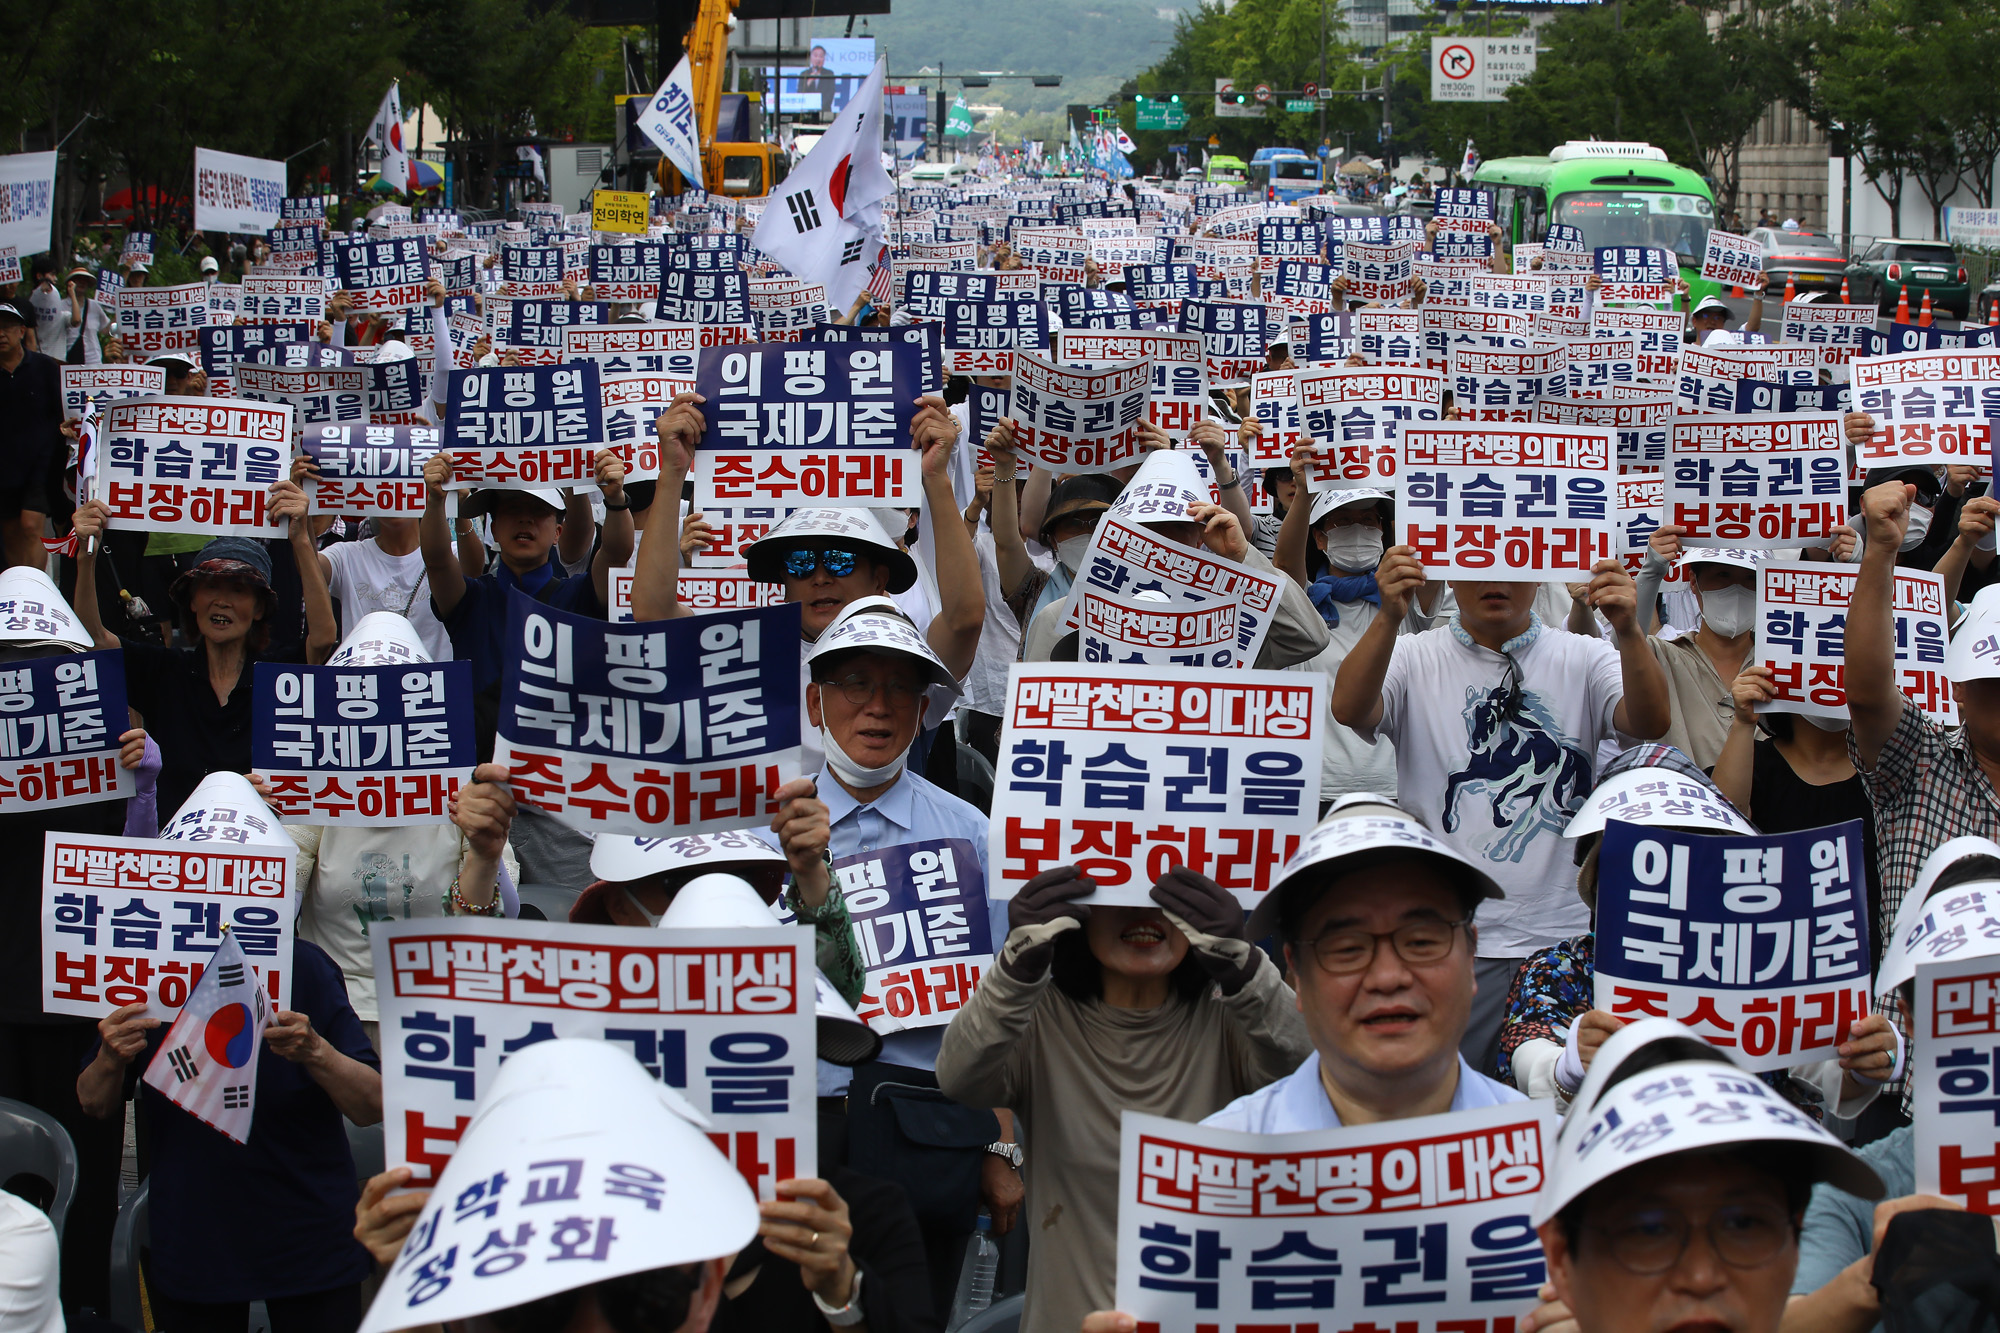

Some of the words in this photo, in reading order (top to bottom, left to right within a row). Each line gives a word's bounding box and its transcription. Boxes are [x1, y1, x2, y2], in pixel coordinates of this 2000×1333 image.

[285, 198, 320, 210] 의평원
[1440, 190, 1488, 204] 의평원
[284, 208, 322, 219] 국제기준
[595, 208, 644, 224] 전의학연
[1438, 204, 1489, 218] 국제기준
[284, 219, 324, 229] 준수하라!
[1263, 225, 1316, 240] 의평원
[1332, 218, 1382, 231] 의평원
[1388, 216, 1423, 229] 의평원
[272, 238, 316, 252] 국제기준
[273, 227, 314, 242] 의평원
[1332, 229, 1383, 242] 국제기준
[1388, 228, 1424, 242] 국제기준
[272, 252, 318, 264] 준수하라!
[348, 240, 420, 268] 의평원
[508, 250, 558, 266] 의평원
[597, 247, 661, 265] 의평원
[1020, 247, 1086, 266] 학습권을
[1095, 248, 1152, 262] 학습권을
[1262, 242, 1317, 256] 국제기준
[1435, 242, 1487, 256] 국제기준
[1602, 248, 1660, 266] 의평원
[1708, 247, 1760, 270] 학습권을
[675, 252, 736, 272] 의평원
[1347, 258, 1411, 280] 학습권을
[350, 262, 424, 288] 국제기준
[508, 266, 558, 282] 국제기준
[597, 266, 661, 282] 국제기준
[1132, 265, 1188, 284] 의평원
[1286, 264, 1343, 283] 의평원
[1602, 266, 1664, 283] 국제기준
[666, 271, 741, 298] 의평원
[912, 274, 987, 296] 의평원
[1133, 282, 1192, 299] 국제기준
[1346, 280, 1412, 300] 보장하라!
[1600, 285, 1666, 301] 준수하라!
[244, 296, 322, 315] 학습권을
[351, 284, 428, 310] 준수하라!
[1068, 291, 1130, 310] 의평원
[1472, 292, 1546, 310] 학습권을
[120, 304, 207, 329] 학습권을
[522, 304, 598, 325] 의평원
[662, 299, 744, 322] 국제기준
[956, 304, 1038, 326] 의평원
[1186, 304, 1260, 332] 의평원
[956, 327, 1039, 349] 국제기준
[720, 350, 893, 396] 의평원
[460, 370, 584, 408] 의평원
[1456, 375, 1567, 405] 학습권을
[1015, 384, 1144, 434] 학습권을
[456, 408, 590, 445] 국제기준
[718, 402, 897, 446] 국제기준
[320, 426, 440, 447] 의평원
[110, 438, 282, 484] 학습권을
[452, 448, 595, 483] 준수하라!
[712, 454, 903, 499] 준수하라!
[1674, 456, 1842, 497] 학습권을
[1406, 472, 1608, 520] 학습권을
[1406, 524, 1609, 570] 보장하라!
[520, 613, 761, 694] 의평원
[274, 670, 446, 720] 의평원
[514, 682, 768, 760] 국제기준
[272, 721, 451, 768] 국제기준
[510, 750, 781, 826] 준수하라!
[1010, 739, 1306, 816] 학습권을
[1628, 836, 1852, 914] 의평원
[54, 892, 282, 956] 학습권을
[1622, 910, 1860, 986] 국제기준
[408, 1216, 618, 1308] 정상화
[1138, 1214, 1548, 1311] 학습권을
